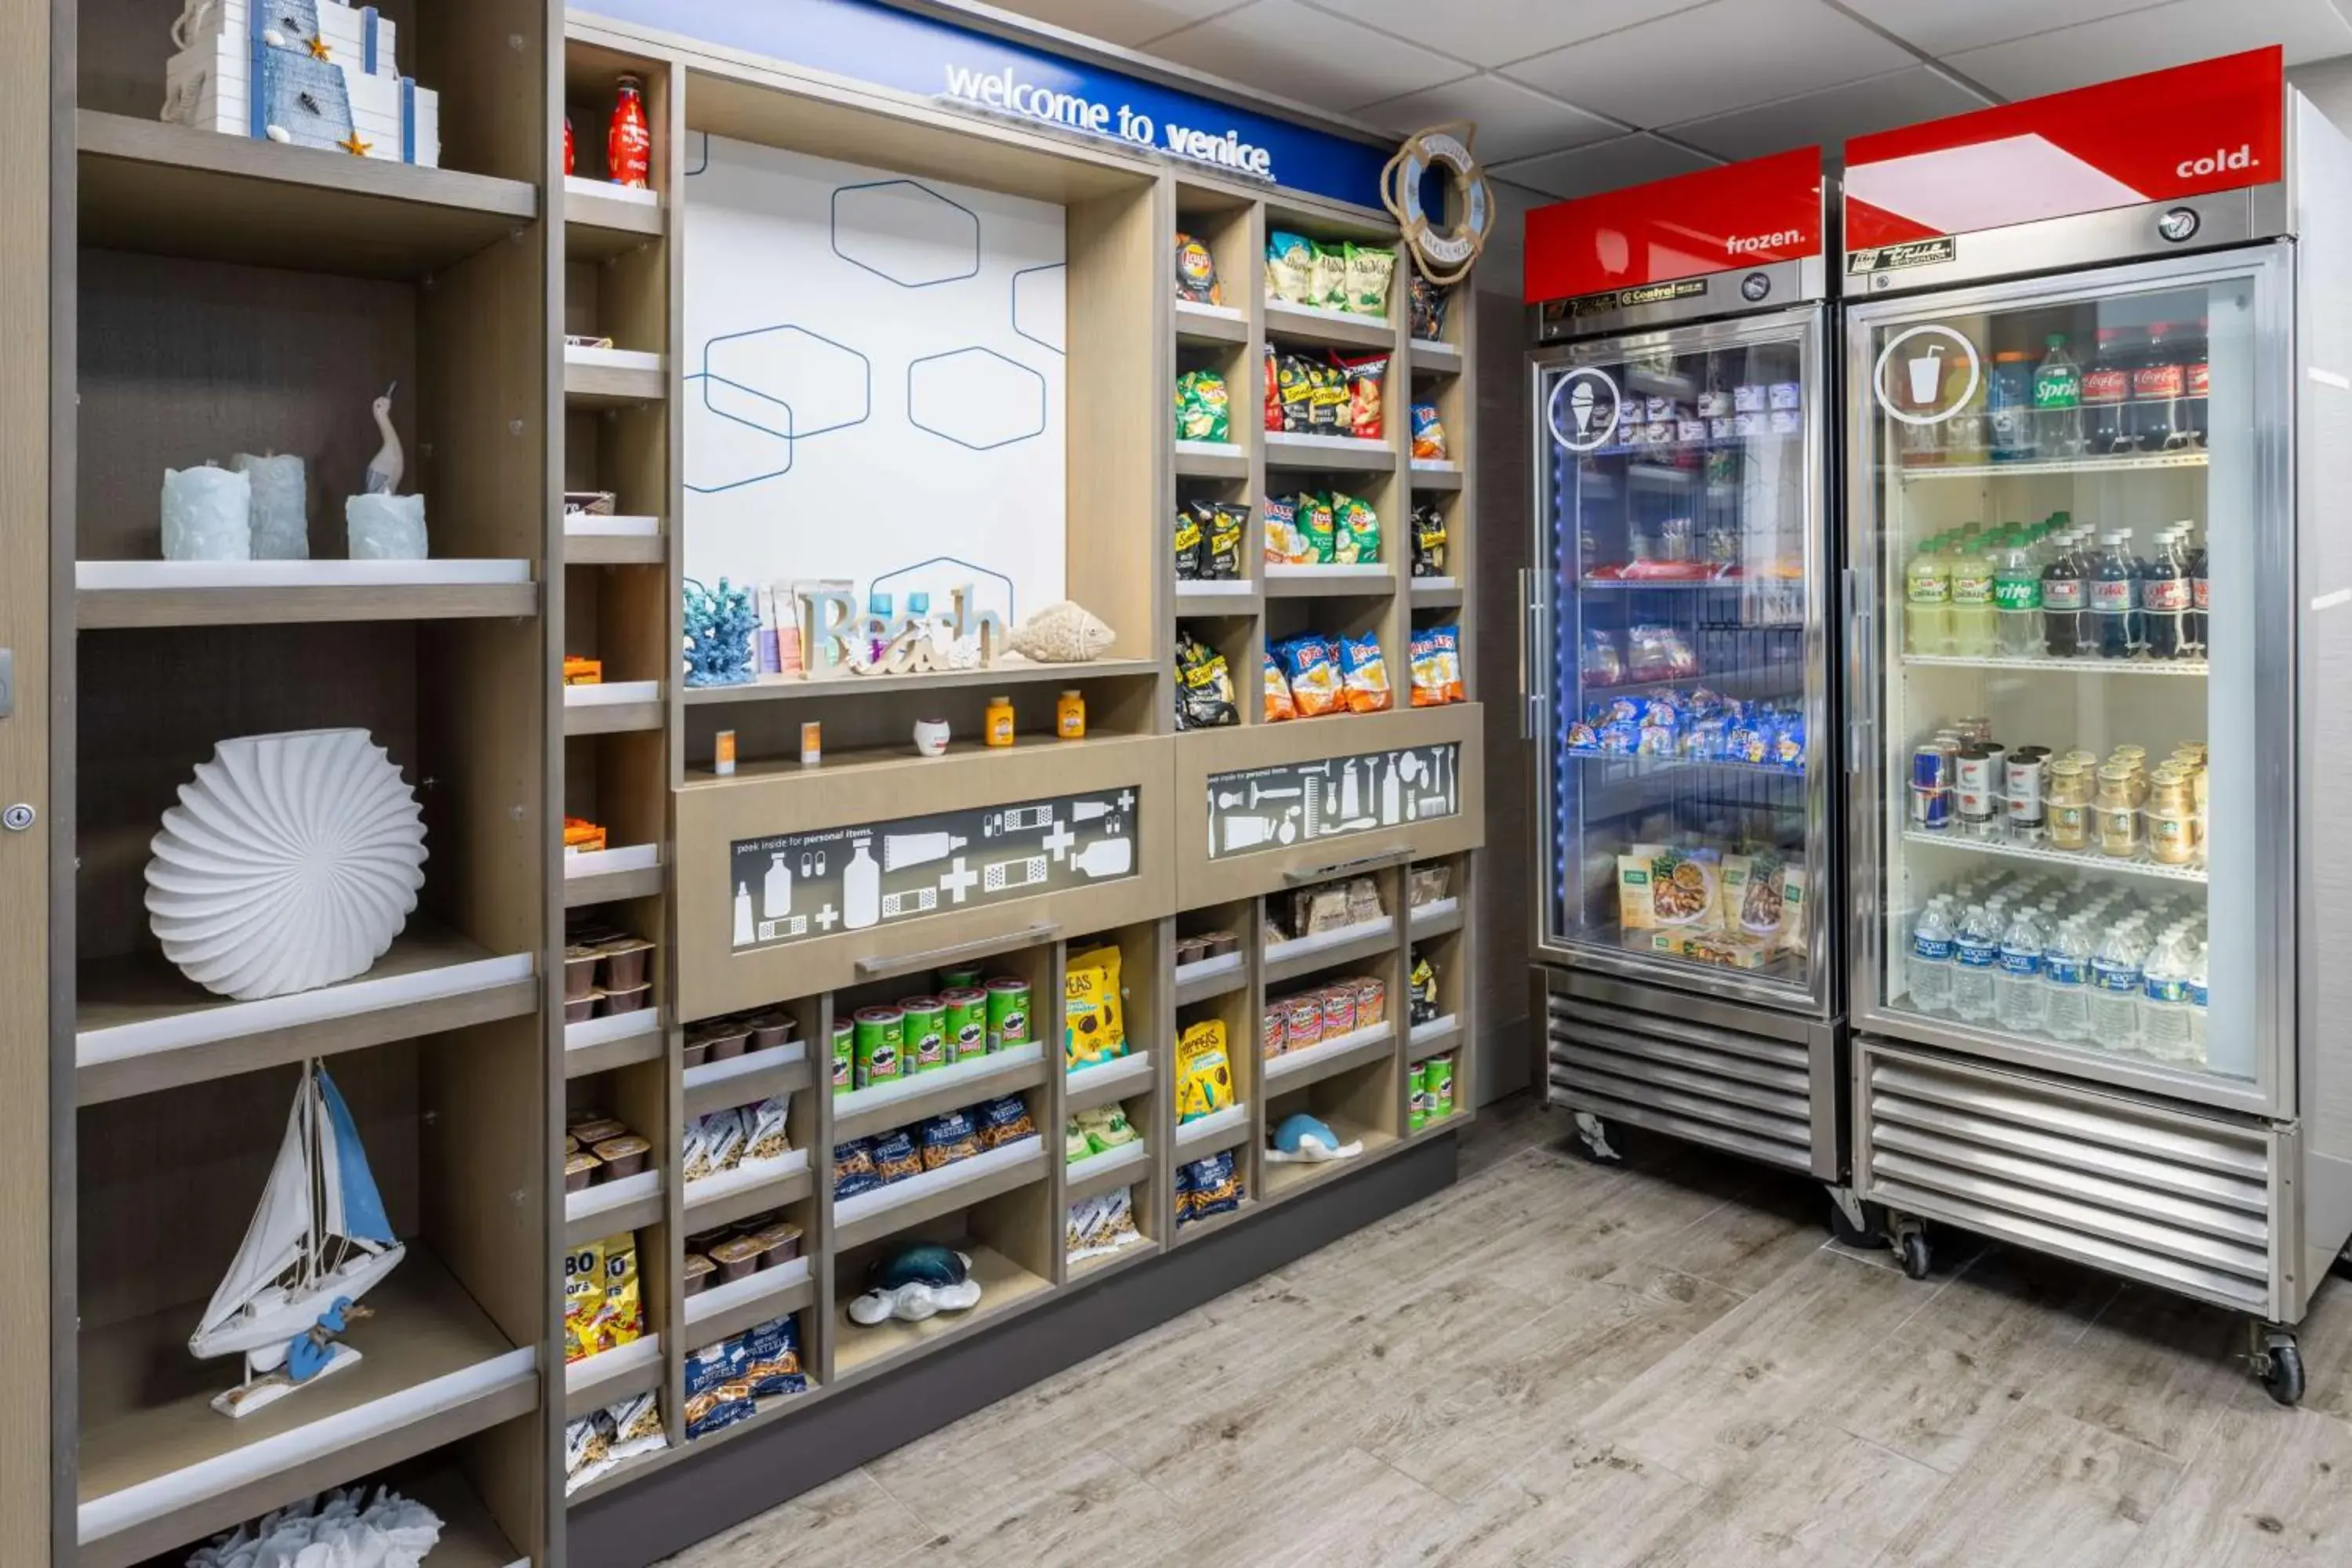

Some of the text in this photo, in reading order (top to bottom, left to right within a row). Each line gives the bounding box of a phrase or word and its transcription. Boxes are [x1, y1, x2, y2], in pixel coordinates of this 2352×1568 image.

[946, 64, 1109, 134] welcome
[1117, 104, 1152, 143] to
[2176, 143, 2259, 178] cold.
[1726, 229, 1806, 255] frozen.
[2037, 378, 2078, 399] Sprit
[1996, 583, 2031, 600] rite
[736, 840, 759, 855] peek
[761, 839, 789, 850] inside
[789, 837, 802, 846] for
[804, 830, 844, 847] personal
